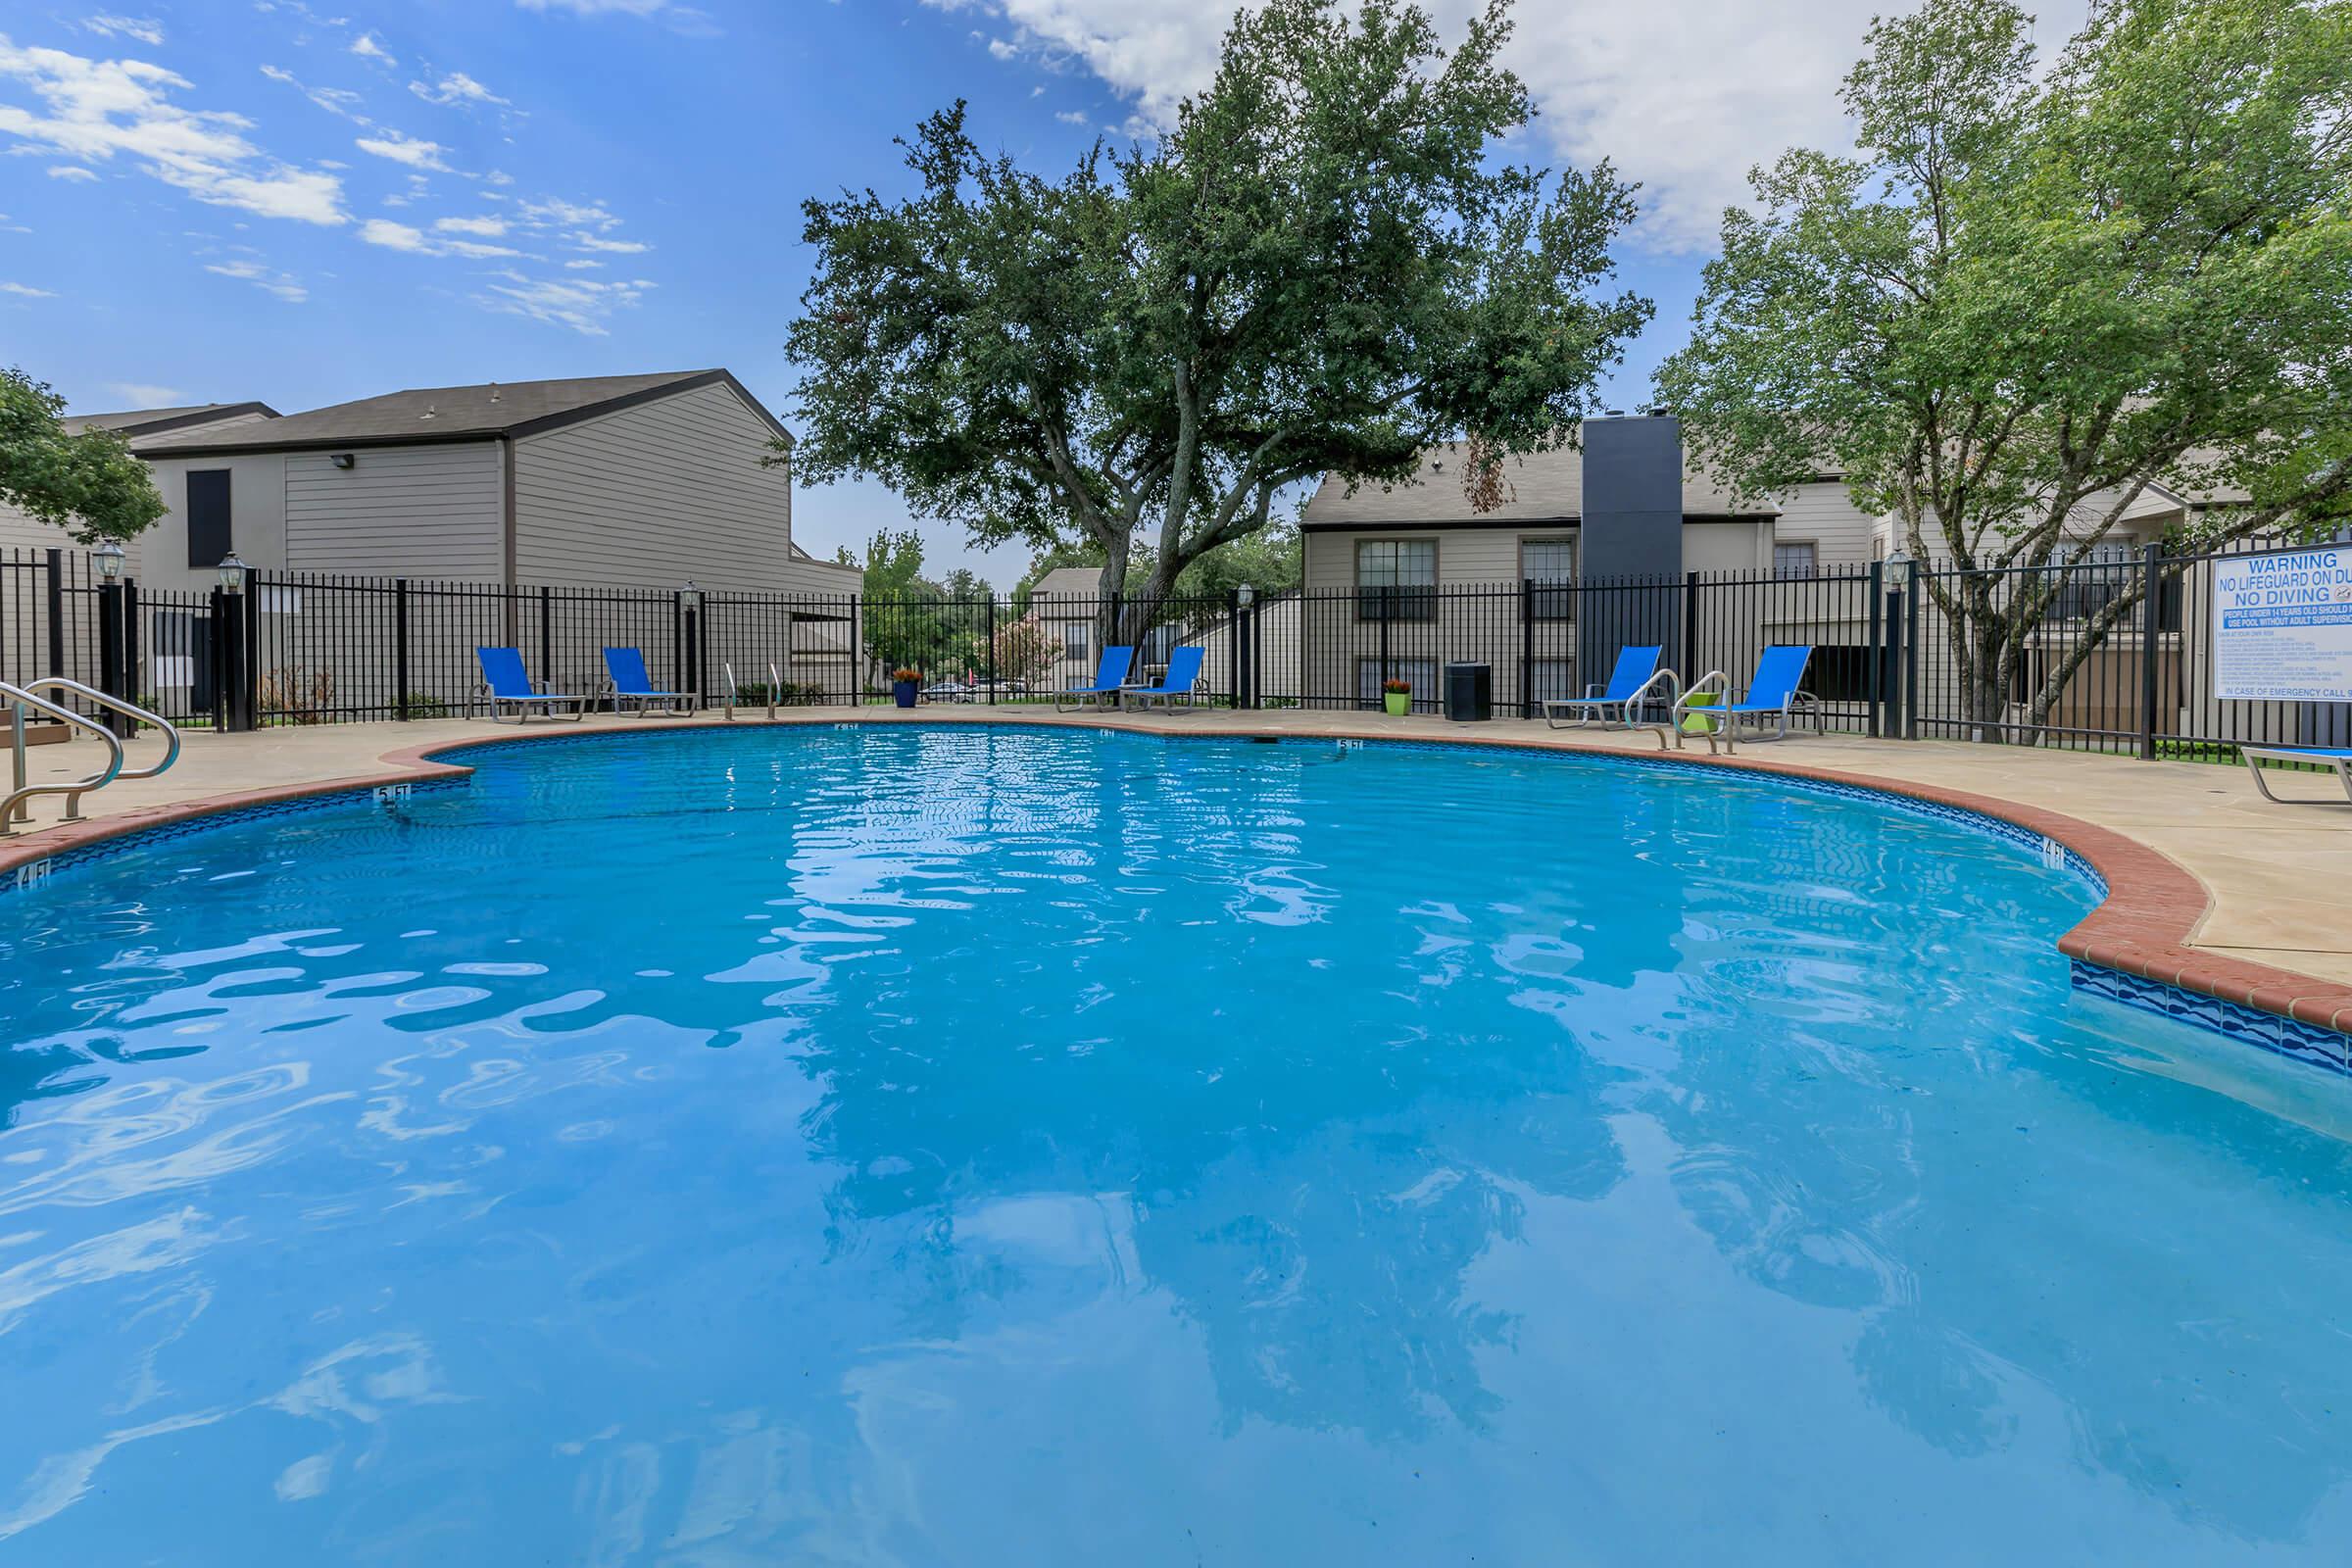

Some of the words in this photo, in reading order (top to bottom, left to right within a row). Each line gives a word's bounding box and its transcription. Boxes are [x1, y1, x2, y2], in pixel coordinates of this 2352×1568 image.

[2249, 553, 2337, 573] WARNING
[2220, 577, 2235, 592] NO
[2239, 571, 2309, 591] LIFEGUARD
[2313, 570, 2331, 586] ON
[2235, 592, 2260, 607] NO
[2267, 587, 2329, 605] DIVING
[2225, 609, 2248, 618] PEOPLE
[2280, 607, 2301, 616] YEARS
[2303, 606, 2318, 615] OLD
[2319, 605, 2348, 614] SHOULD
[2242, 617, 2258, 627] POOL
[2260, 616, 2288, 626] WITHOUT
[2289, 615, 2311, 625] ADULT
[2257, 687, 2267, 696] OF
[2270, 688, 2321, 697] EMERGENCY
[2323, 688, 2345, 698] CALL
[1340, 739, 1348, 750] 5
[1351, 740, 1361, 751] FT
[378, 787, 388, 801] 5
[395, 785, 408, 800] FT
[36, 860, 48, 879] FT
